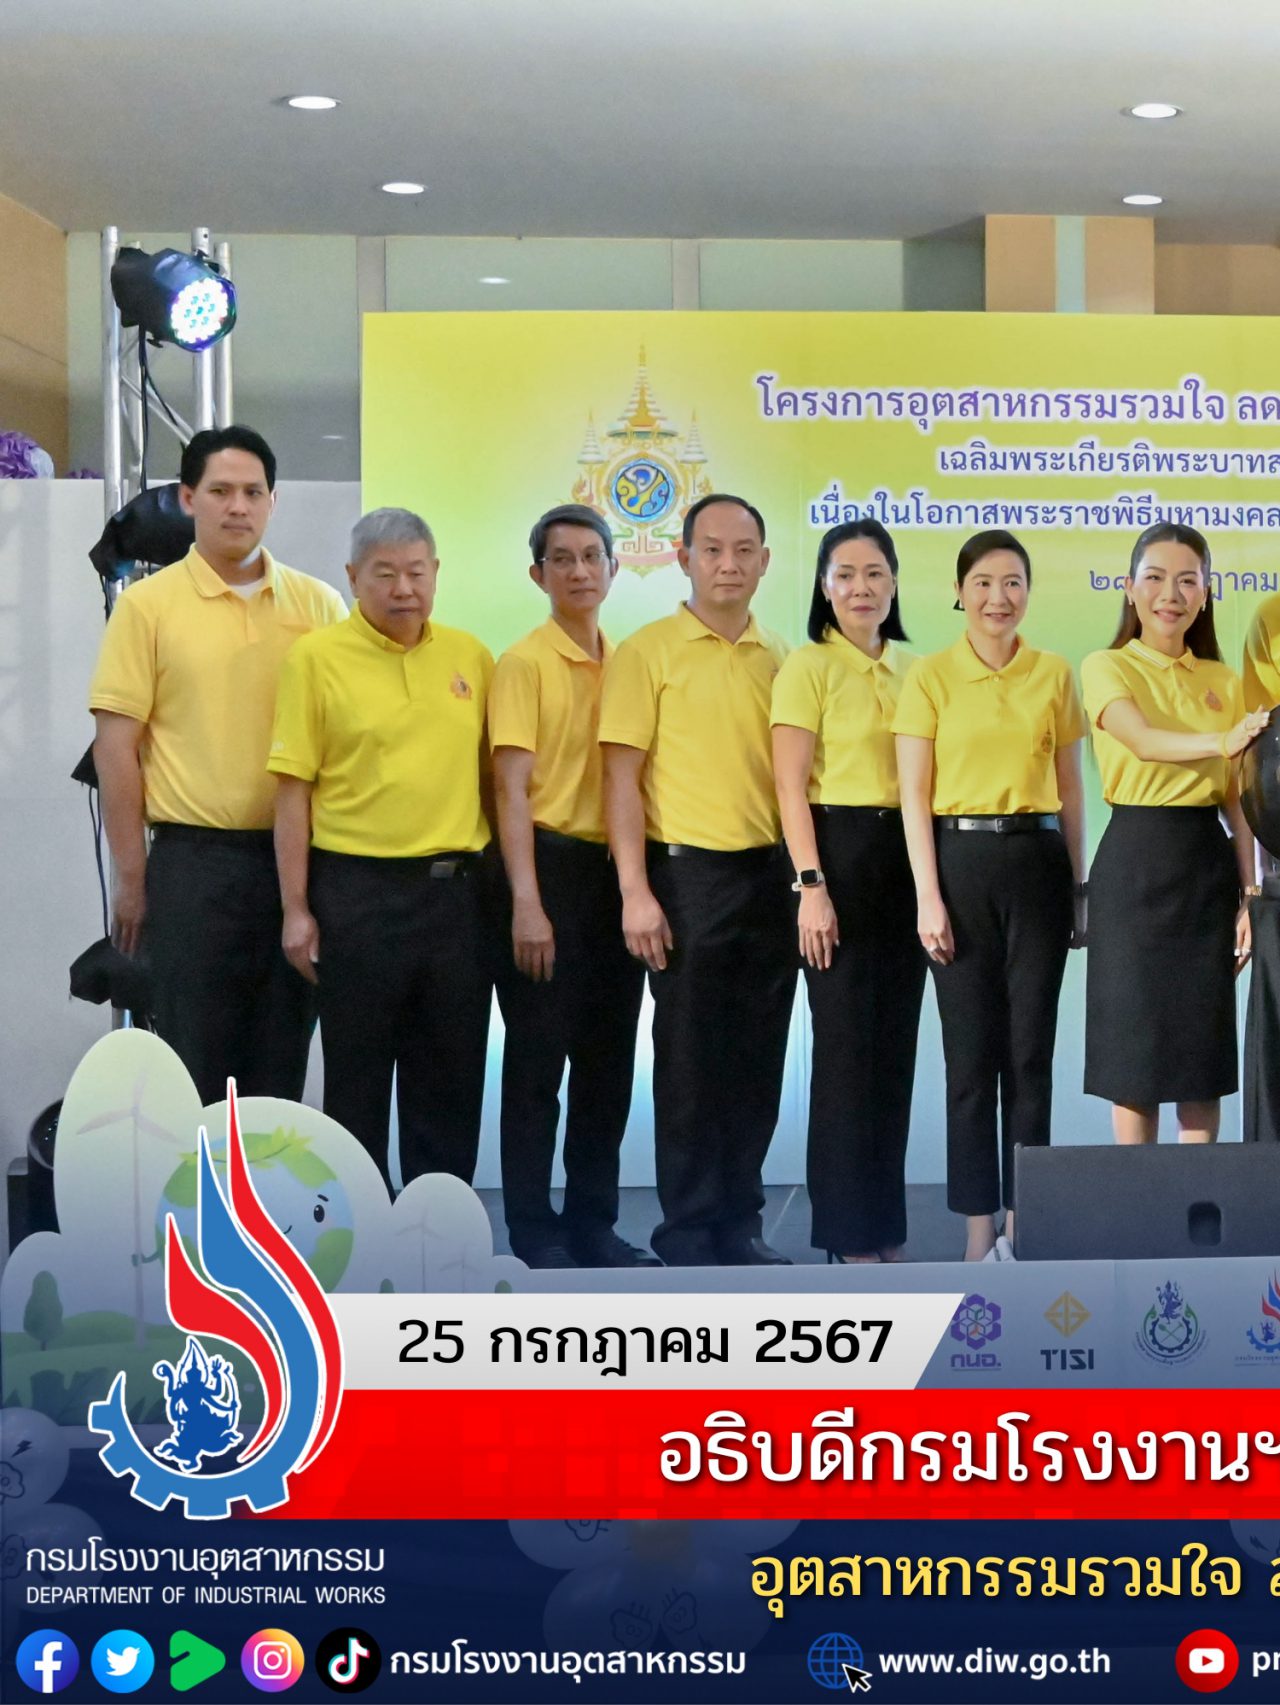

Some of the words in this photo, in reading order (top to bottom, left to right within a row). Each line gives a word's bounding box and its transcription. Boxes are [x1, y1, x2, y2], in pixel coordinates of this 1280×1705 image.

[756, 375, 1226, 430] โครงการอุตสาหกรรมรวมใจ
[1209, 571, 1278, 601] ฎาคม
[1040, 1348, 1095, 1371] TISI
